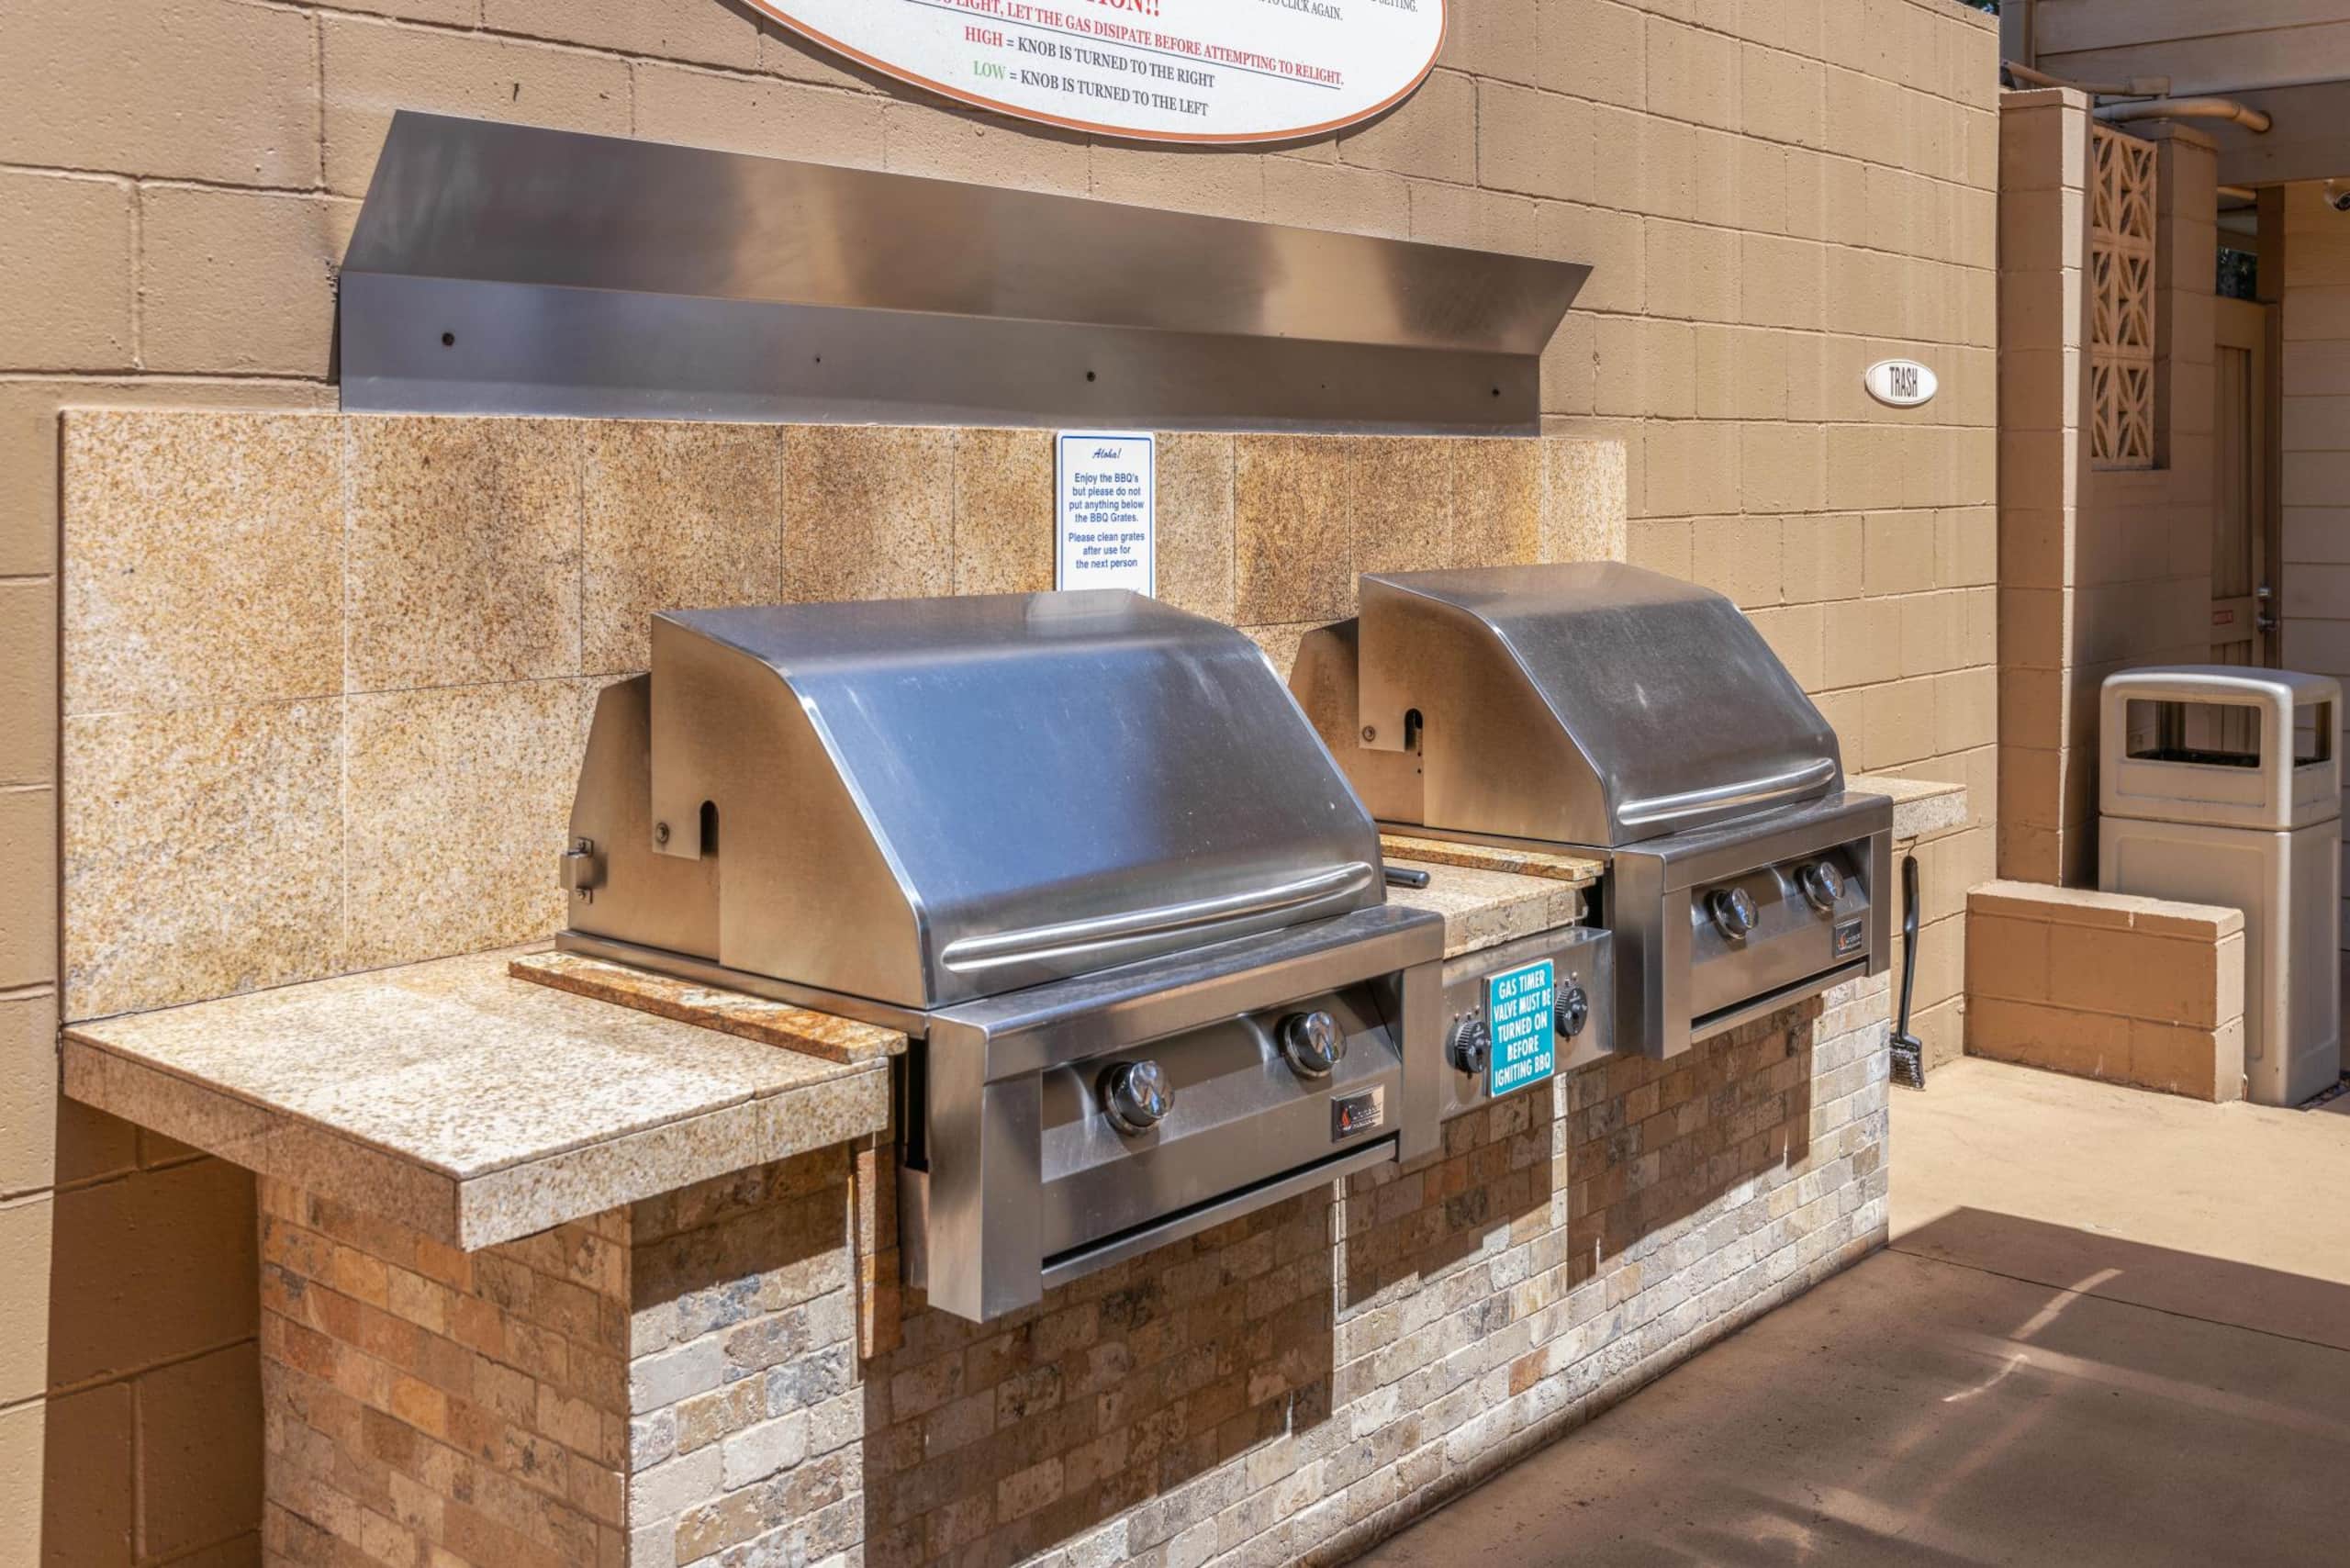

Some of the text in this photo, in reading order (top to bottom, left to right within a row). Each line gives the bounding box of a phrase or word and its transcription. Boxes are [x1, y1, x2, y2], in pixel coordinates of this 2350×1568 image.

[1311, 2, 1343, 20] AGAIN.
[1007, 2, 1034, 19] LET
[1035, 7, 1063, 28] THE
[1066, 15, 1091, 33] GAS
[1094, 21, 1152, 45] DISIPATE
[1155, 33, 1202, 56] BEFORE
[1203, 43, 1277, 72] ATTEMPTING
[1279, 60, 1293, 74] TO
[1295, 63, 1344, 86] RELIGHT.
[965, 26, 1002, 48] HIGH
[1017, 37, 1057, 58] KNOB
[1059, 45, 1072, 62] IS
[1075, 48, 1128, 72] TURNED
[1130, 59, 1147, 75] TO
[1149, 62, 1175, 81] THE
[1177, 68, 1215, 88] RIGHT
[973, 61, 1006, 81] LOW
[1020, 70, 1058, 90] KNOB
[1062, 77, 1075, 93] IS
[1078, 80, 1130, 103] TURNED
[1132, 90, 1149, 106] TO
[1151, 94, 1177, 111] THE
[1179, 98, 1209, 117] LEFT
[1889, 366, 1918, 398] TRASH
[1091, 447, 1123, 460] Aloha!
[1074, 473, 1139, 486] Enjoy the BBQ's
[1072, 487, 1141, 498] but please do not
[1069, 499, 1145, 512] put anything below
[1075, 512, 1139, 523] the BBQ Grates.
[1068, 532, 1146, 543] Please clean grates
[1082, 545, 1102, 555] after
[1119, 545, 1131, 554] for
[1076, 559, 1138, 569] the next person
[1498, 969, 1546, 1000] GAS TIMER
[1494, 988, 1552, 1023] VALVE MUST BE
[1497, 1010, 1549, 1044] TURNED ON
[1507, 1035, 1540, 1062] BEFORE
[1494, 1051, 1551, 1088] IGNITING BBQ
